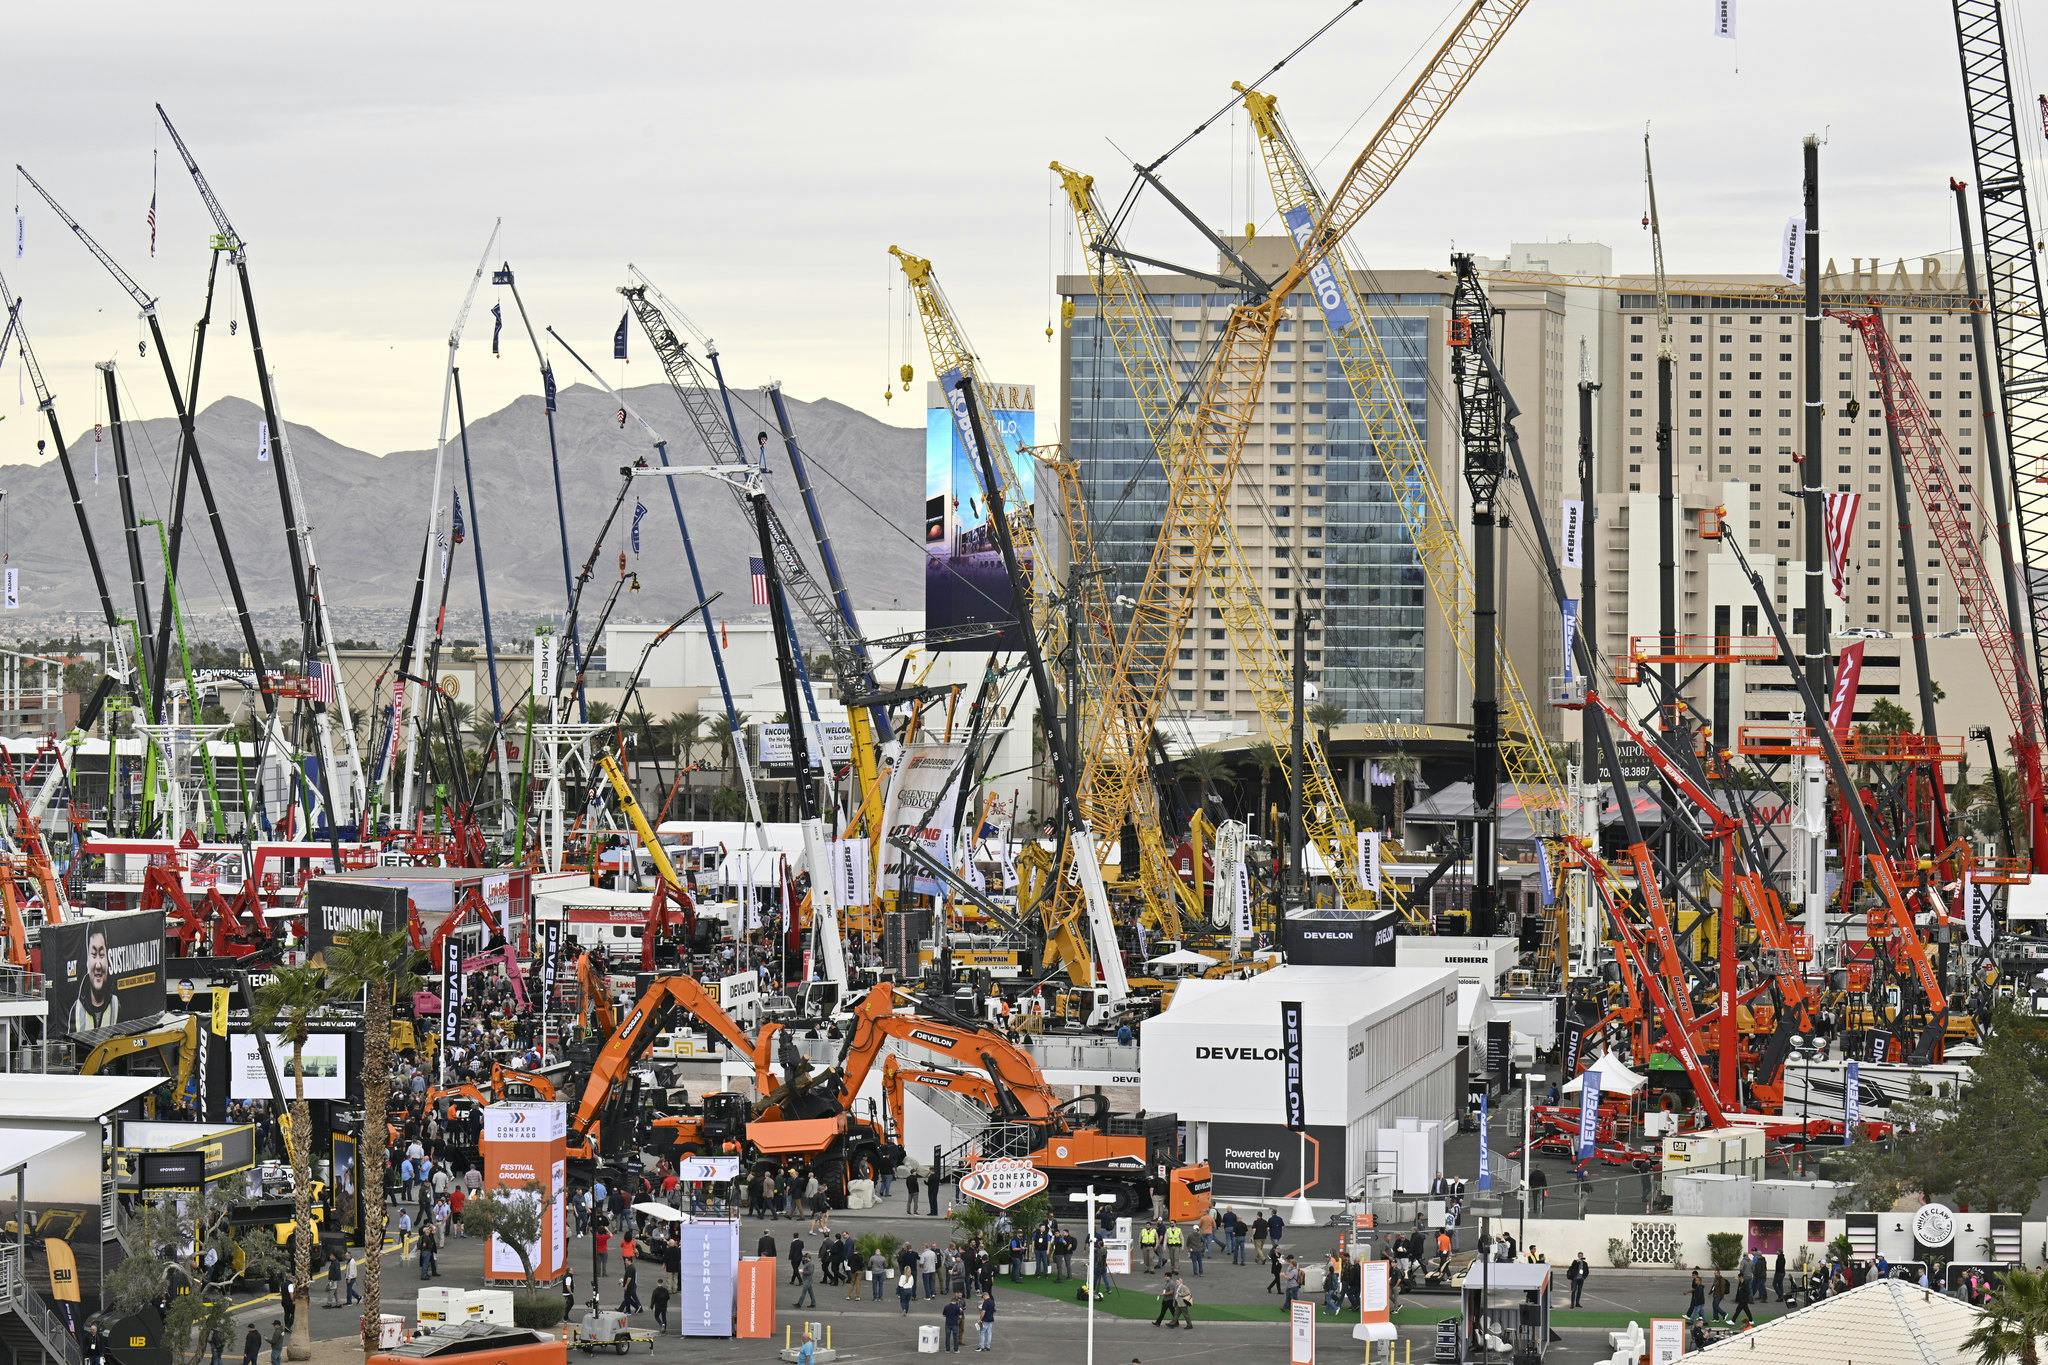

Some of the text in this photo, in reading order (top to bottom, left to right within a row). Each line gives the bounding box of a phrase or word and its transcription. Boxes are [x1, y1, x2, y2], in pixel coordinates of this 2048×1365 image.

[780, 543, 799, 572] GROVE
[541, 651, 549, 695] MERLO
[1364, 725, 1433, 738] SAHARA
[1304, 931, 1353, 939] DEVELON
[1375, 925, 1394, 946] DEVELON
[107, 939, 160, 976] SUSTAINABILITY
[1445, 956, 1489, 964] LIEBHERR
[447, 944, 458, 1041] DEVELON
[730, 980, 755, 998] DEVELON
[622, 1012, 643, 1038] DOOSAN
[916, 1031, 953, 1047] DEVELON
[1287, 1010, 1300, 1126] DEVELON
[920, 1075, 949, 1086] DEVELON
[1581, 1087, 1599, 1149] TEUPEN
[1674, 1142, 1686, 1151] CAT
[1225, 1148, 1280, 1160] Powered by
[500, 1163, 534, 1171] FESTIVAL
[976, 1160, 1032, 1171] WELCOME
[1225, 1160, 1273, 1169] Innovation
[499, 1172, 536, 1180] GROUNDS
[992, 1172, 1038, 1181] CONEXPO
[992, 1180, 1038, 1189] CON/AGG
[1917, 1208, 1950, 1231] WHITE CLAW
[702, 1233, 711, 1327] INFORMATION
